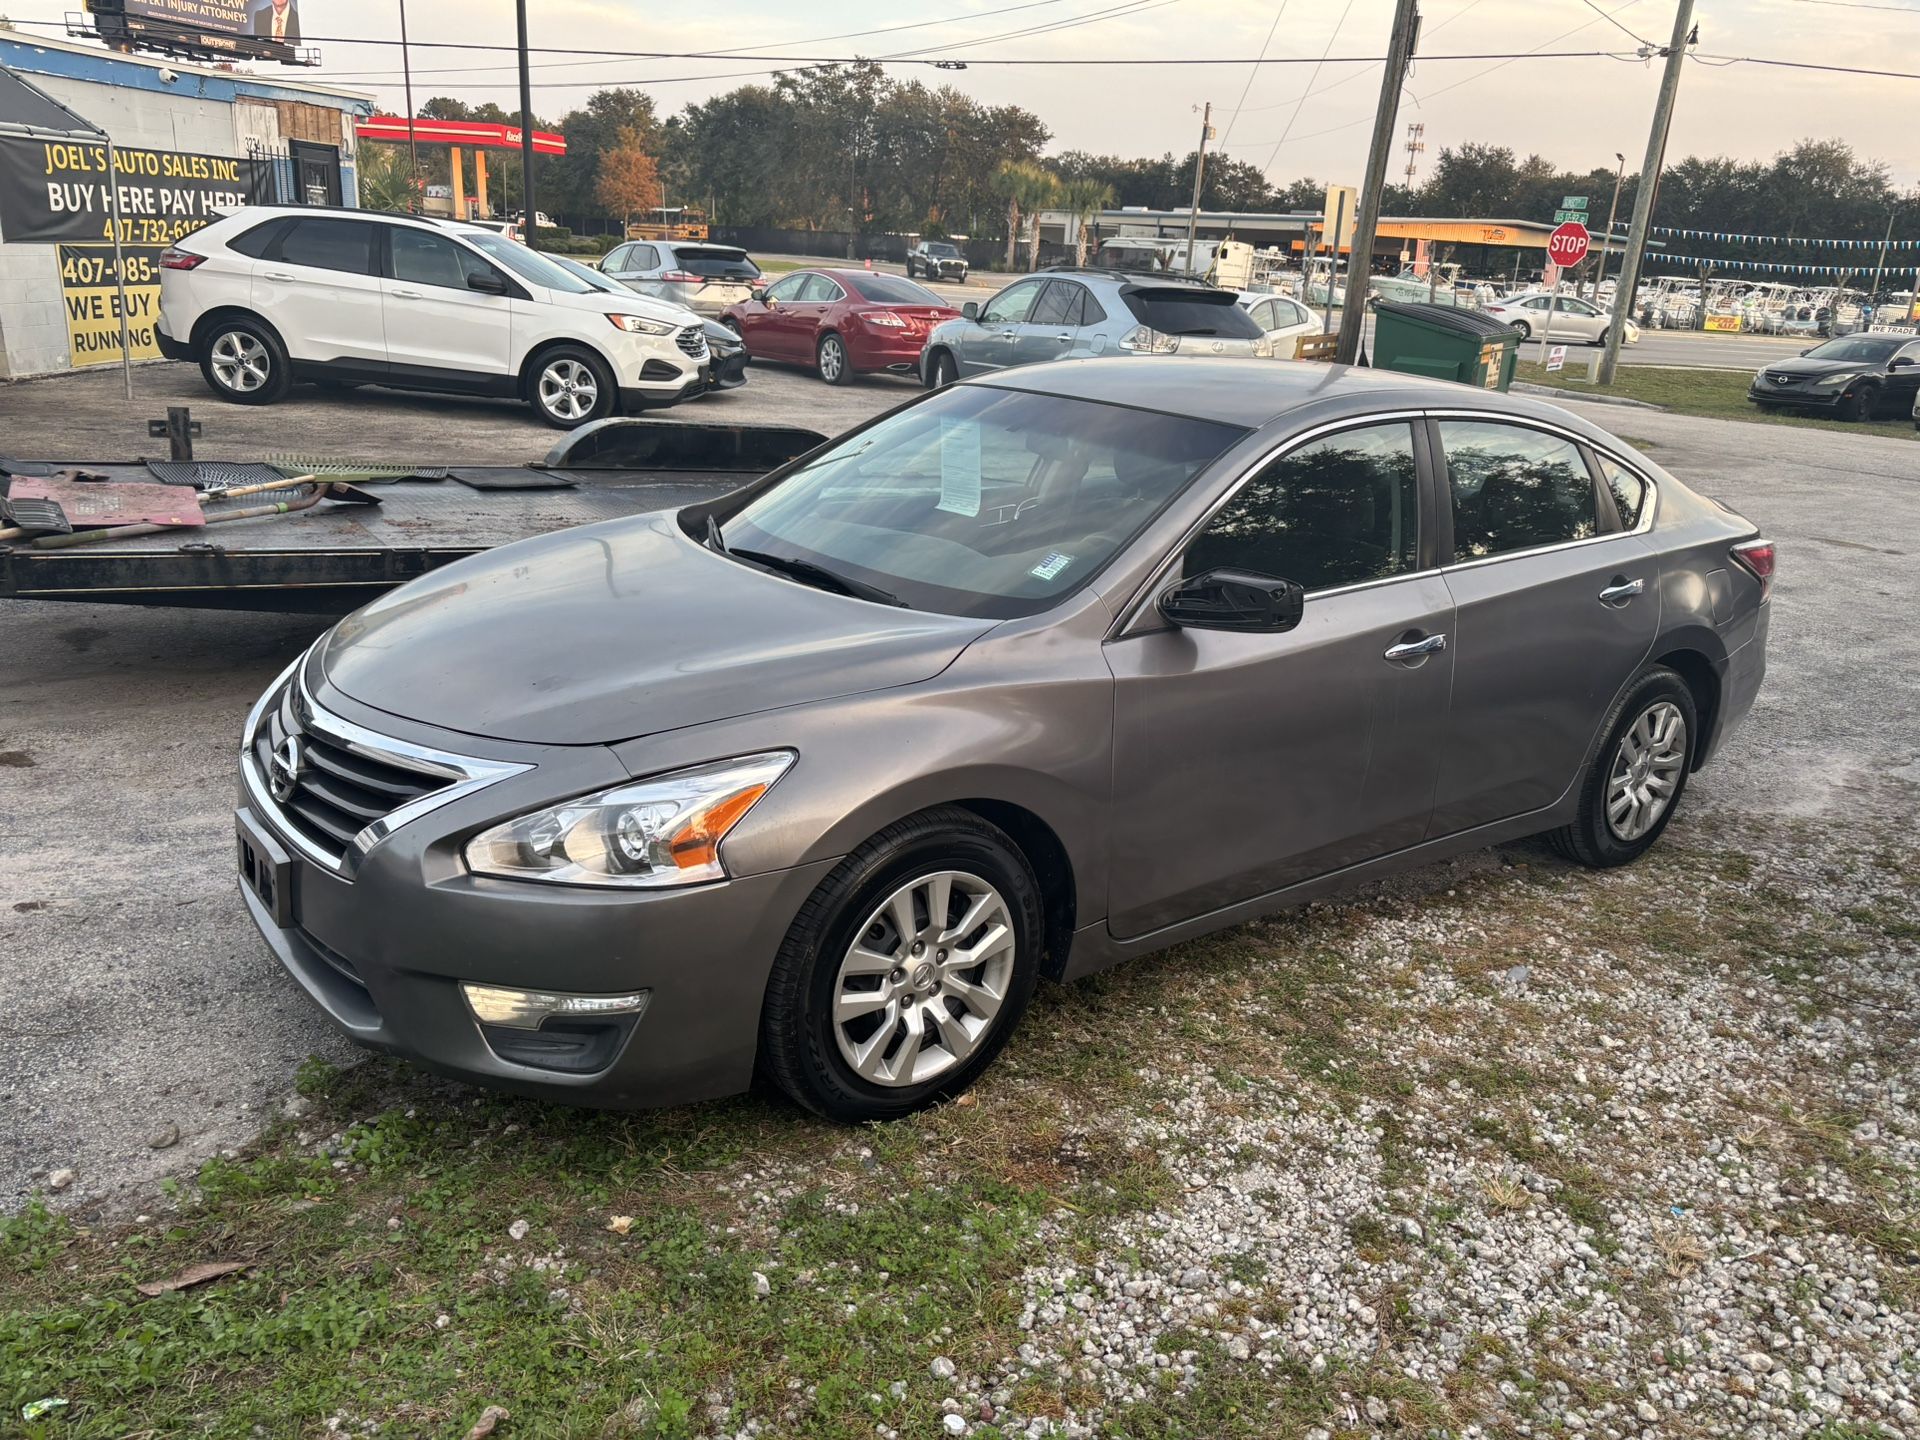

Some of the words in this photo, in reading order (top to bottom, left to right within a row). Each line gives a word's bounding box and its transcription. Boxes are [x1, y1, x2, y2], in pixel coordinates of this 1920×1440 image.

[167, 0, 197, 13] INJURY
[200, 6, 247, 24] ATTORNEYS
[45, 144, 107, 175] JOEL'S
[113, 149, 159, 176] AUTO
[163, 154, 209, 179] SALES
[212, 158, 240, 182] INC
[47, 182, 94, 213] BUY
[160, 188, 195, 216] PAY
[1551, 234, 1586, 254] STOP
[65, 295, 104, 321] WE
[110, 293, 150, 318] BUY
[74, 328, 152, 353] RUNNNG
[1872, 325, 1886, 333] WE
[1887, 326, 1915, 335] TRADE
